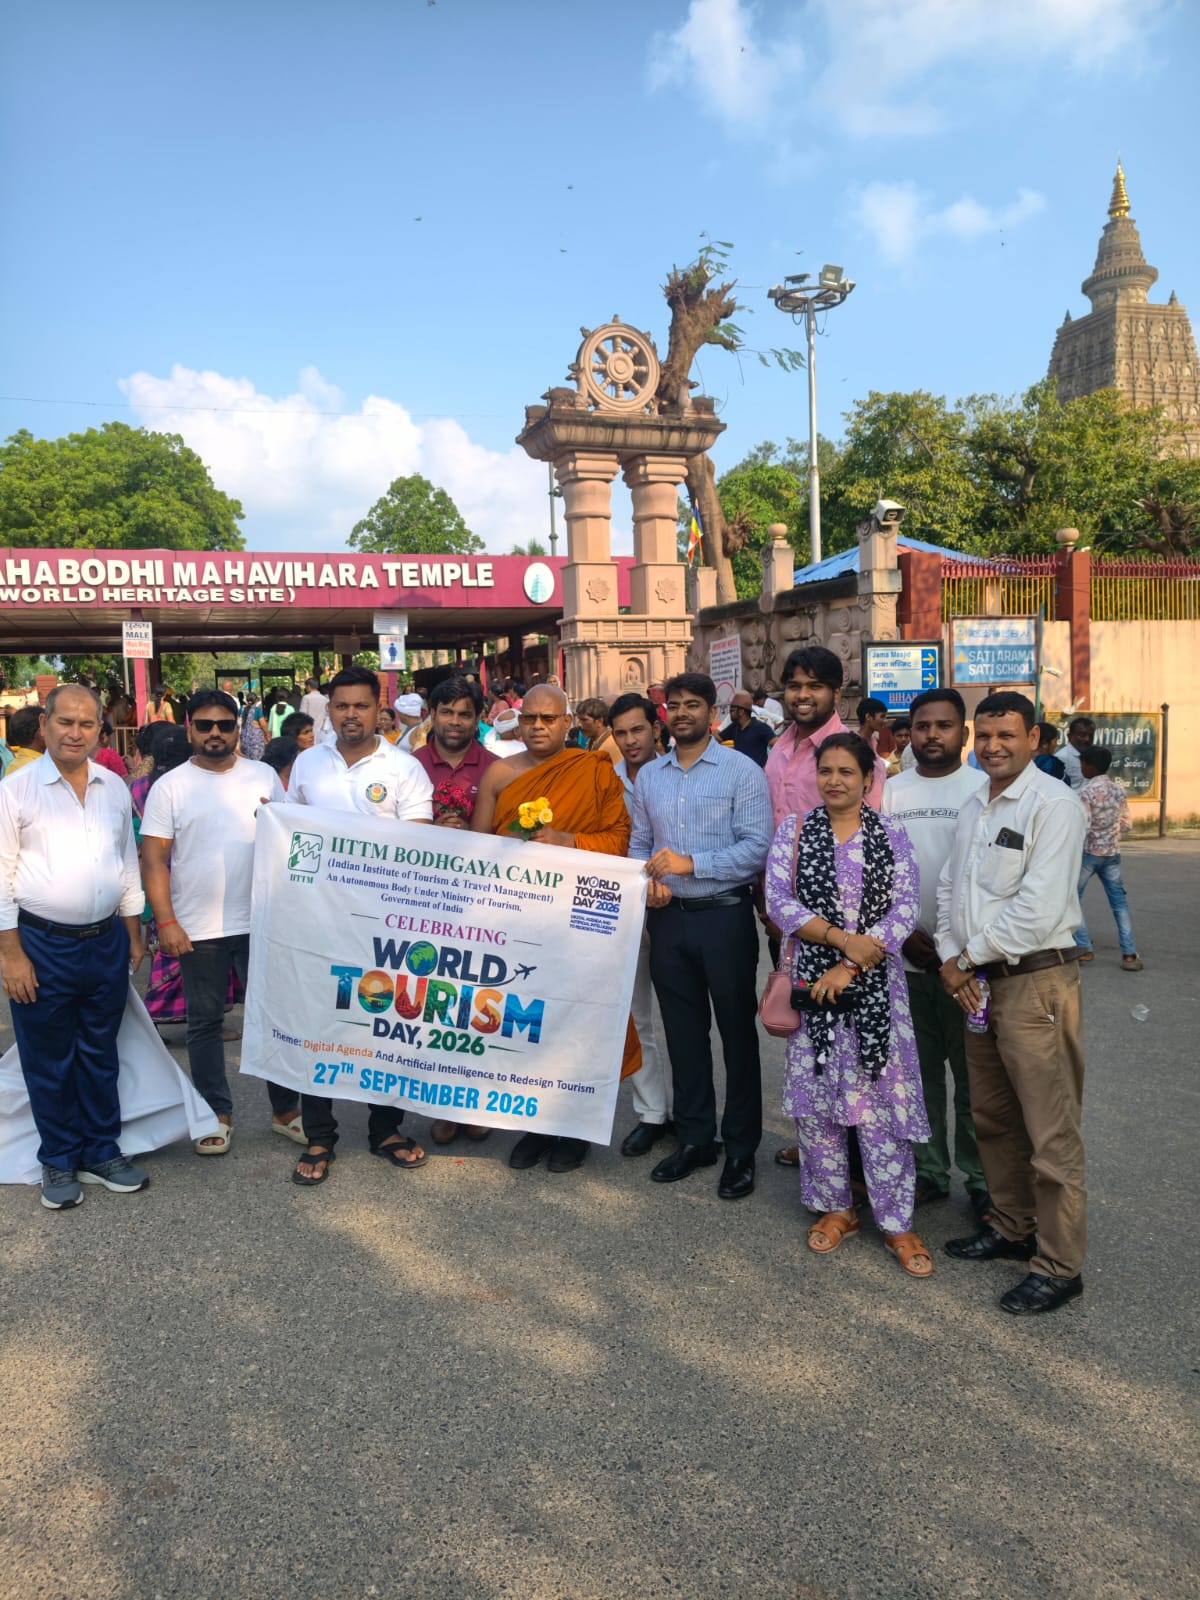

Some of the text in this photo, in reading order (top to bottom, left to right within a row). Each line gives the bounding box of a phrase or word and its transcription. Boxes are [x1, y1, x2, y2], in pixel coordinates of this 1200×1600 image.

[0, 558, 494, 588] HABODHI MAHAVIHARA TEMPLE
[102, 588, 225, 602] HERITAGE
[968, 663, 994, 676] SATI
[290, 874, 314, 884] IITTM
[331, 837, 564, 888] IITTM BODHGAYA CAMP
[326, 873, 338, 881] An
[340, 874, 389, 890] Autonomous
[391, 882, 412, 895] Body
[414, 886, 439, 898] Under
[441, 890, 474, 906] Ministry
[476, 897, 486, 906] of
[328, 858, 554, 904] (Indian Institute of Tourism & Travel Management)
[575, 886, 622, 903] TOURISM
[577, 875, 621, 891] WORLD
[381, 893, 464, 914] Government of India
[573, 896, 620, 913] DAY 2026
[385, 913, 507, 946] CELEBRATING
[373, 937, 508, 984] WORLD
[330, 965, 545, 1044] TOURISM
[373, 1017, 486, 1056] DAY, 2026
[272, 1029, 595, 1094] Theme: Digital Agenda And Artificial Intelligence to Redesign Tourism
[359, 1068, 480, 1110] SEPTEMBER
[486, 1090, 539, 1118] 2026
